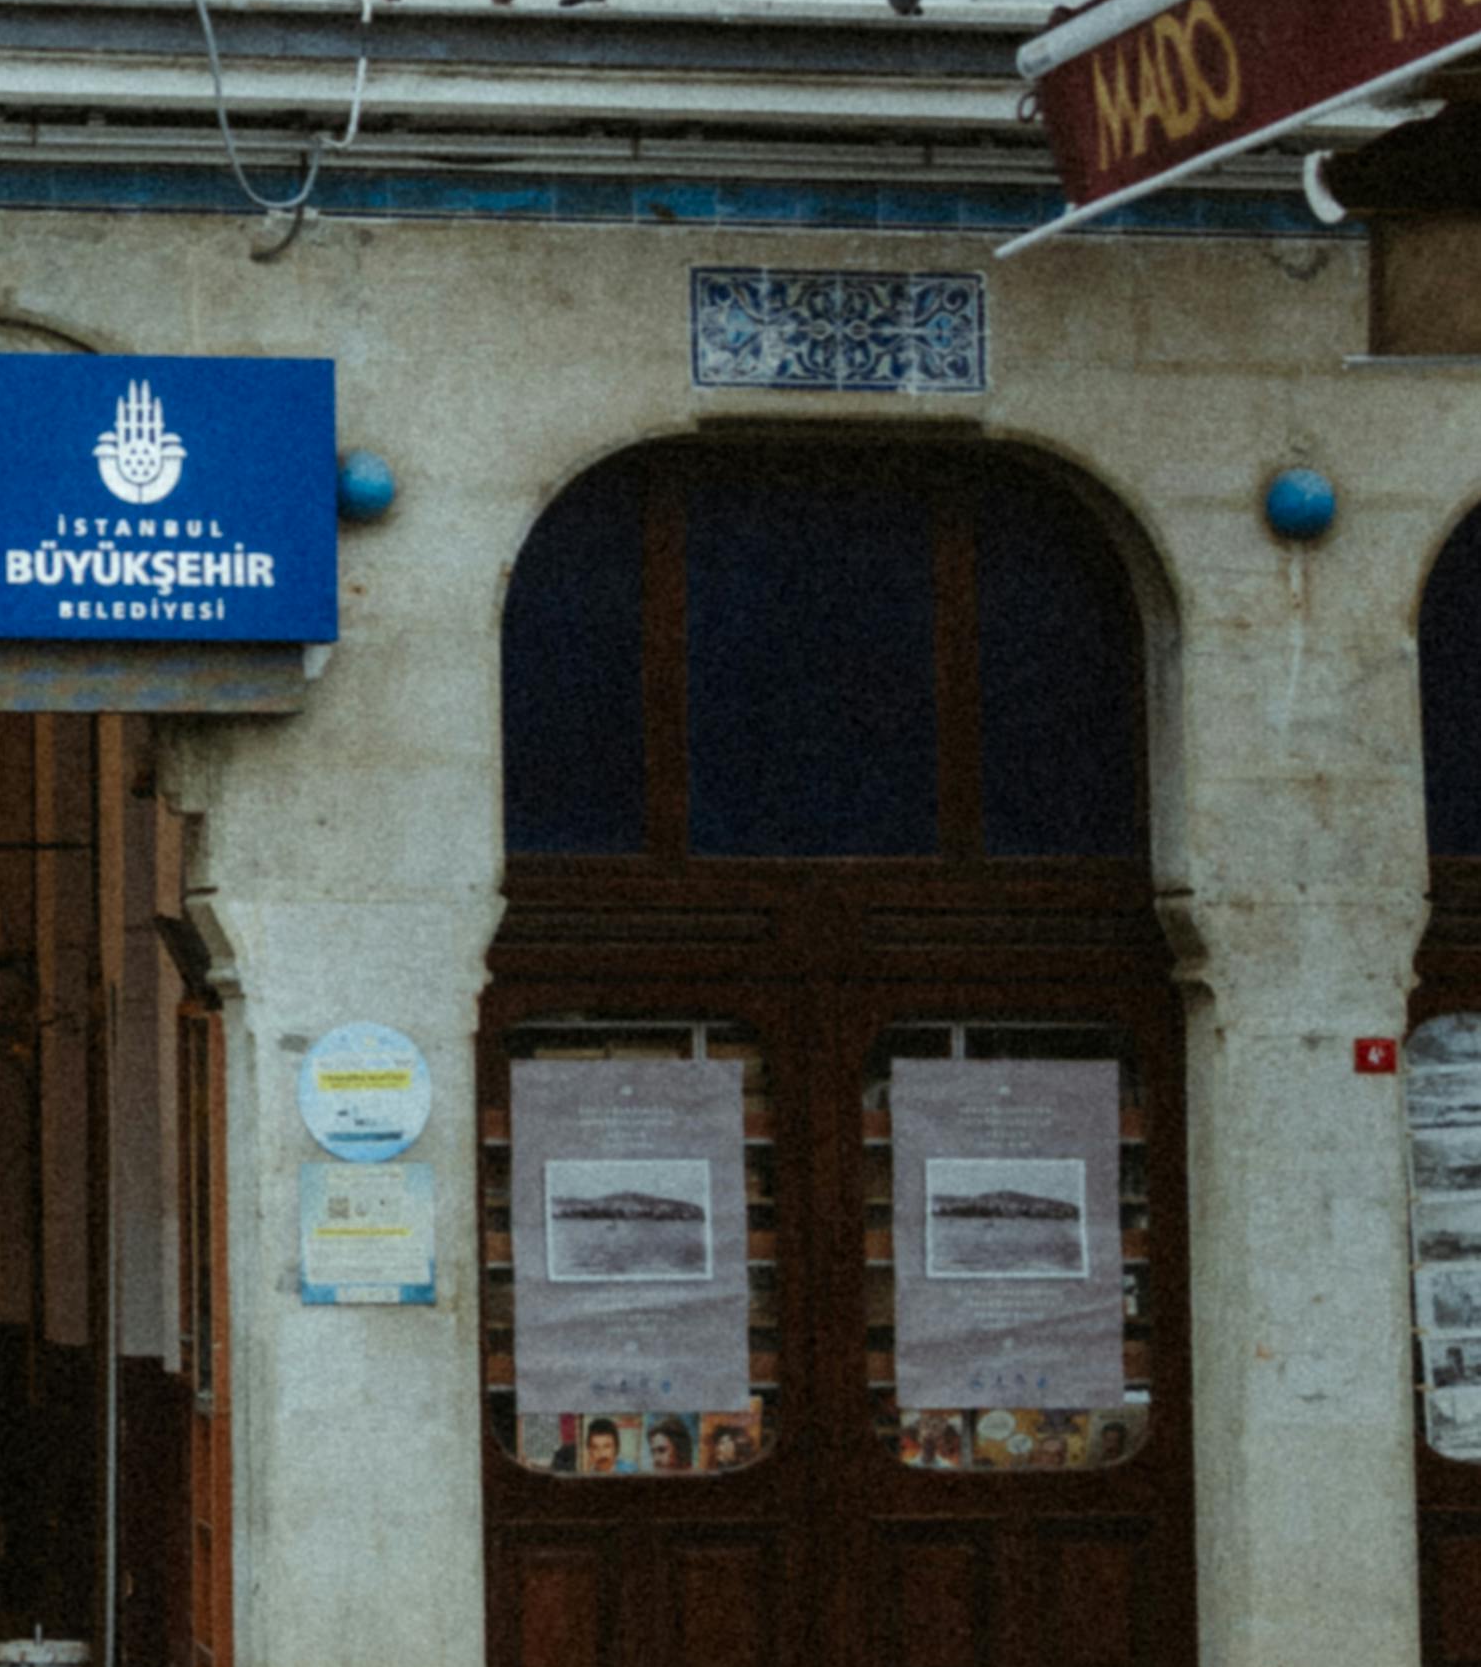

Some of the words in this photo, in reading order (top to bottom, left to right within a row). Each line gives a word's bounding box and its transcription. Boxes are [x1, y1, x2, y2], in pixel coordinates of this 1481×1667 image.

[58, 514, 224, 537] İSTANBUL
[6, 540, 275, 595] BÜYÜKŞEHİR
[59, 598, 225, 620] BELEDİYESİ
